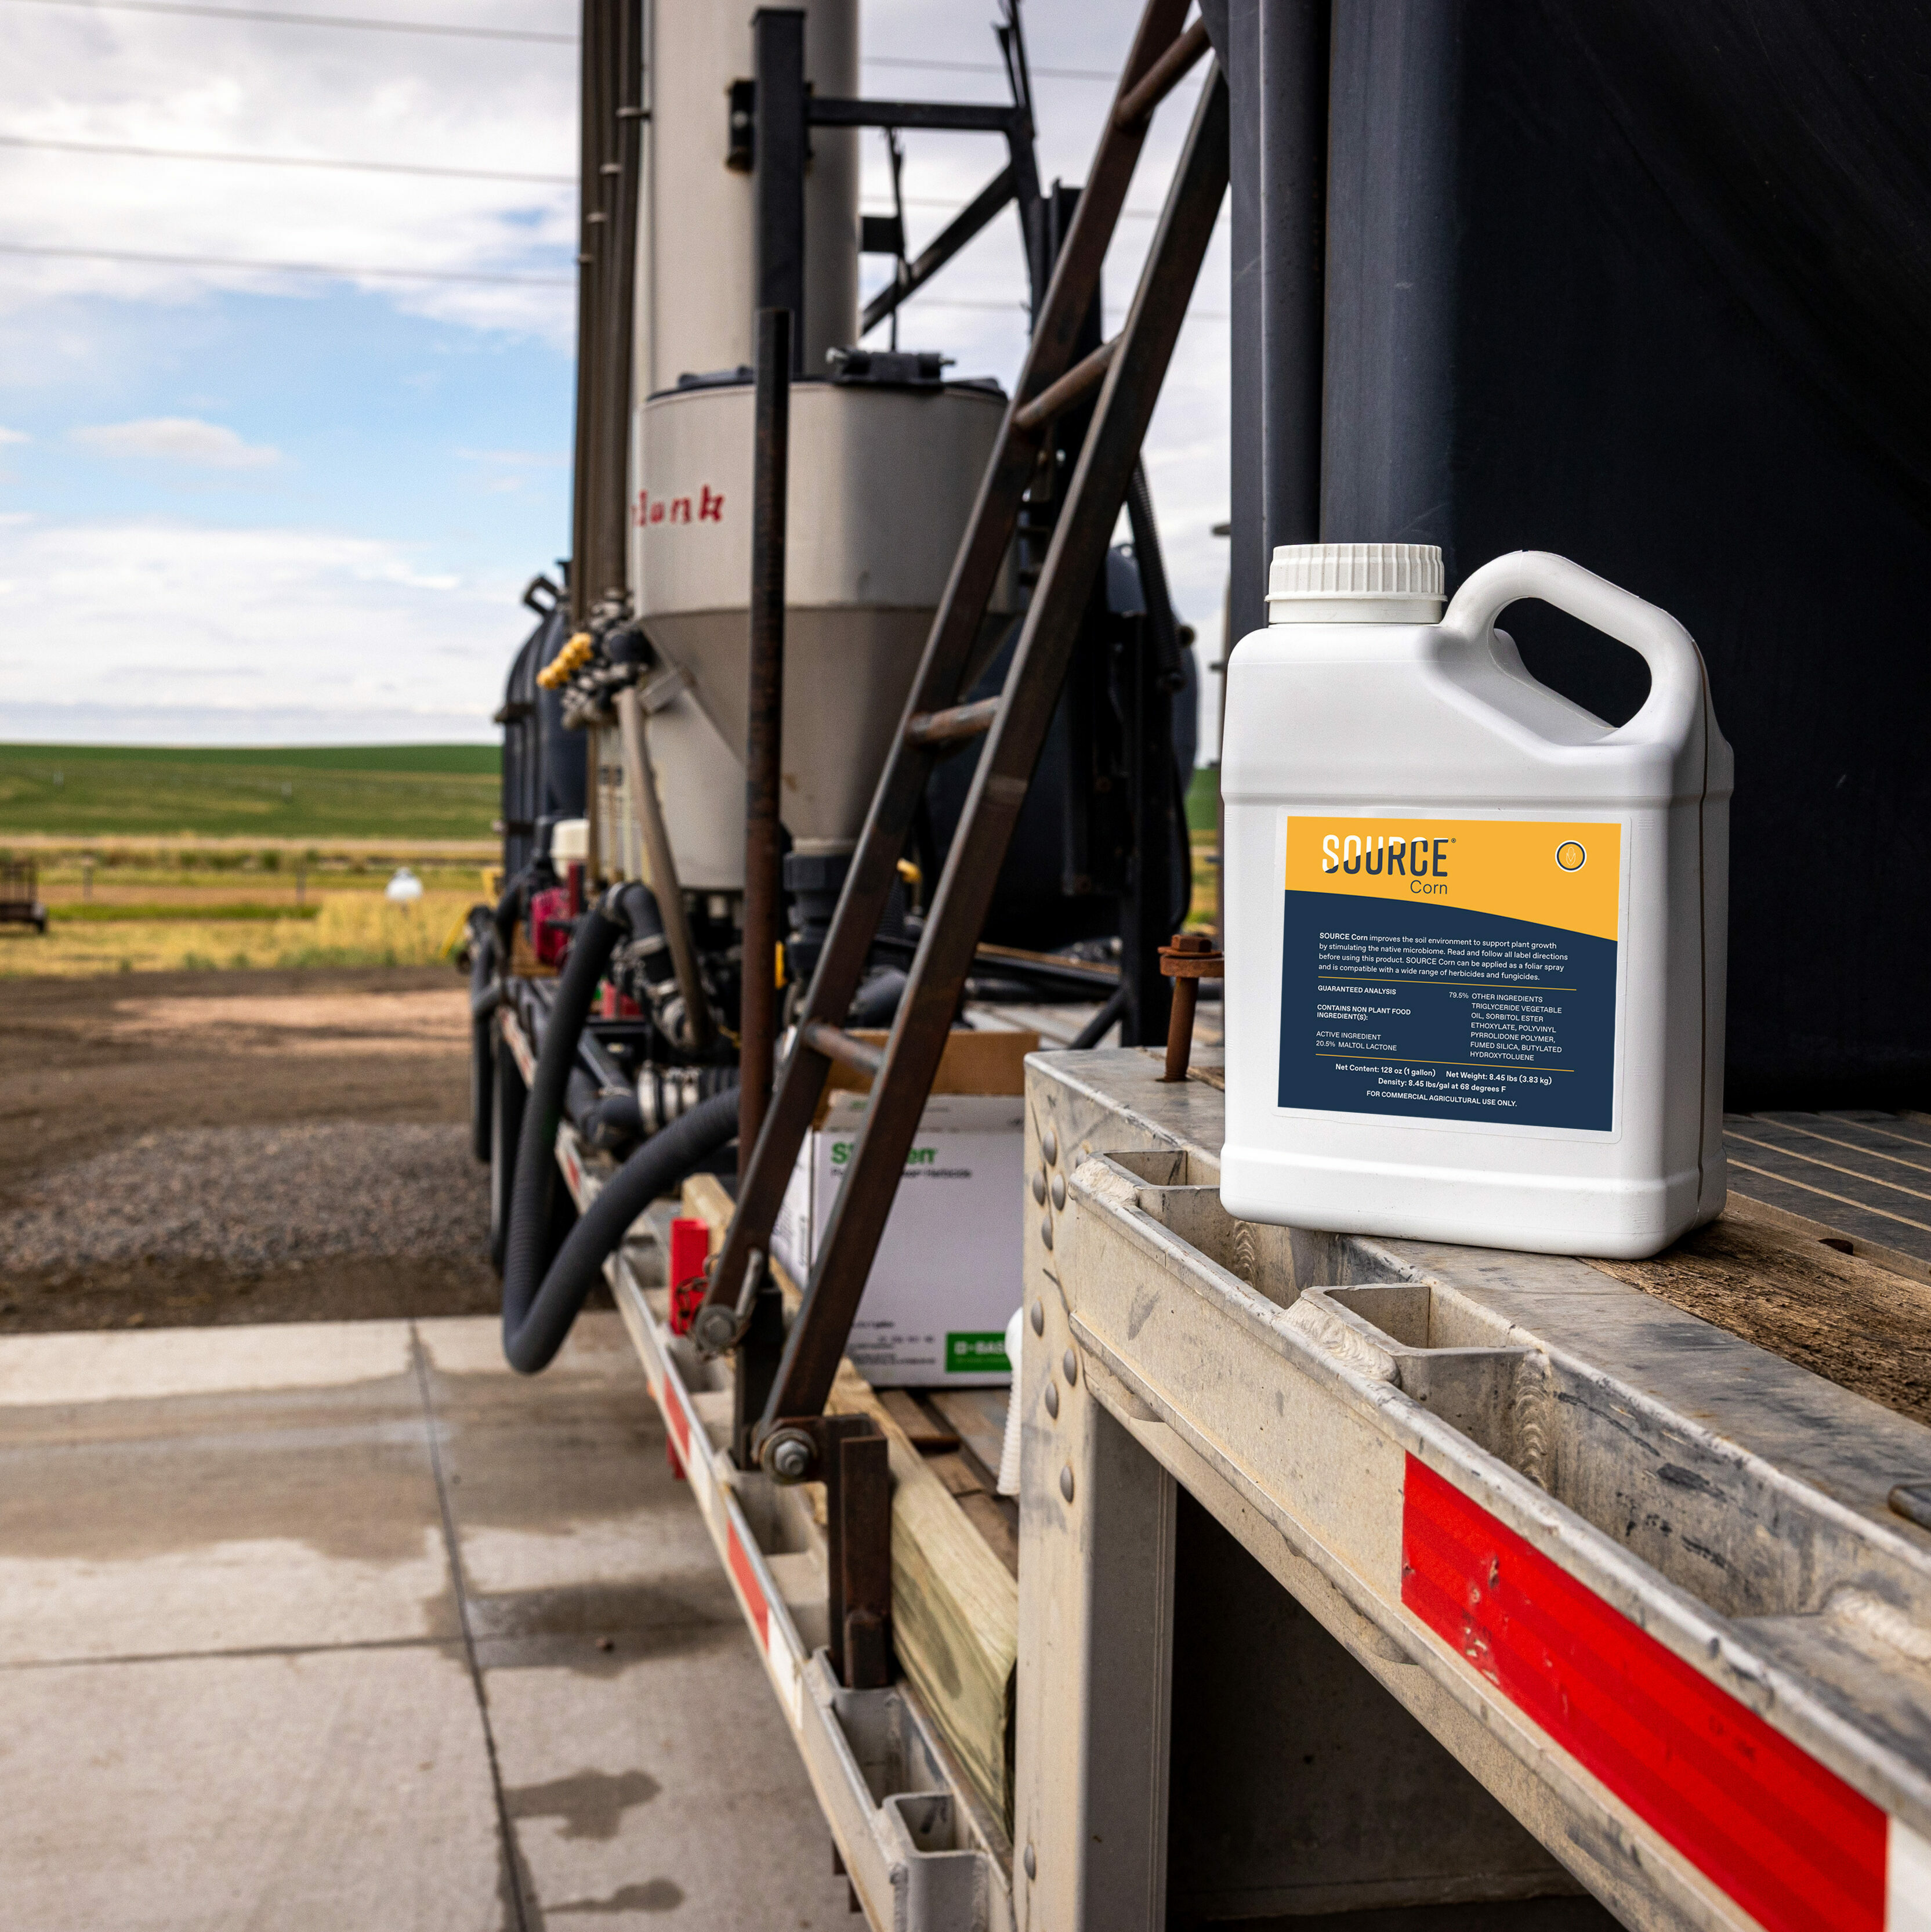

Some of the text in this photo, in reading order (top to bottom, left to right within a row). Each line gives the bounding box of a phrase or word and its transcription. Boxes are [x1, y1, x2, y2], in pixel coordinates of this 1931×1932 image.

[1411, 880, 1447, 894] Corn
[1319, 932, 1350, 940] SOURCE
[1369, 934, 1401, 943] improves
[1428, 938, 1472, 946] environment
[1511, 940, 1530, 949] plant
[1319, 942, 1328, 951] by
[1329, 943, 1367, 953] stimulating
[1403, 946, 1445, 955] microbiome.
[1532, 952, 1568, 960] directions
[1342, 954, 1360, 963] using
[1405, 957, 1437, 965] SOURCE
[1481, 961, 1508, 969] applied
[1524, 962, 1543, 970] foliar
[1448, 969, 1485, 978] herbicides
[1501, 972, 1540, 981] fungicides.
[1317, 985, 1363, 993] GUARANTEED
[1497, 994, 1543, 1003] INGREDIENTS
[1317, 1004, 1351, 1012] CONTAINS
[1471, 1003, 1562, 1014] TRIGLYCERIDE VEGETABLE
[1317, 1012, 1368, 1021] INGREDIENT(S):
[1471, 1012, 1484, 1020] OIL,
[1486, 1013, 1520, 1021] SORBITOL
[1470, 1022, 1556, 1033] ETHOXYLATE, POLYVINYL
[1341, 1032, 1382, 1040] INGREDIENT
[1470, 1032, 1556, 1044] PYRROLIDONE POLYMER,
[1365, 1043, 1397, 1051] LACTONE
[1470, 1041, 1562, 1053] FUMED SILICA, BUTYLATED
[1470, 1051, 1534, 1061] HYDROXYTOLUENE
[1349, 1064, 1379, 1073] Content:
[1404, 1067, 1410, 1076] (1
[1411, 1068, 1436, 1077] gallon)
[1460, 1072, 1488, 1081] Weight:
[1489, 1073, 1505, 1081] 8.45
[1519, 1074, 1538, 1083] (3.83
[1539, 1076, 1552, 1086] kg)
[1378, 1077, 1407, 1087] Density:
[1408, 1079, 1424, 1087] 8.45
[1425, 1081, 1450, 1090] lbs/gal
[1470, 1084, 1499, 1093] degrees
[1381, 1091, 1428, 1101] COMMERCIAL
[1429, 1095, 1481, 1104] AGRICULTURAL
